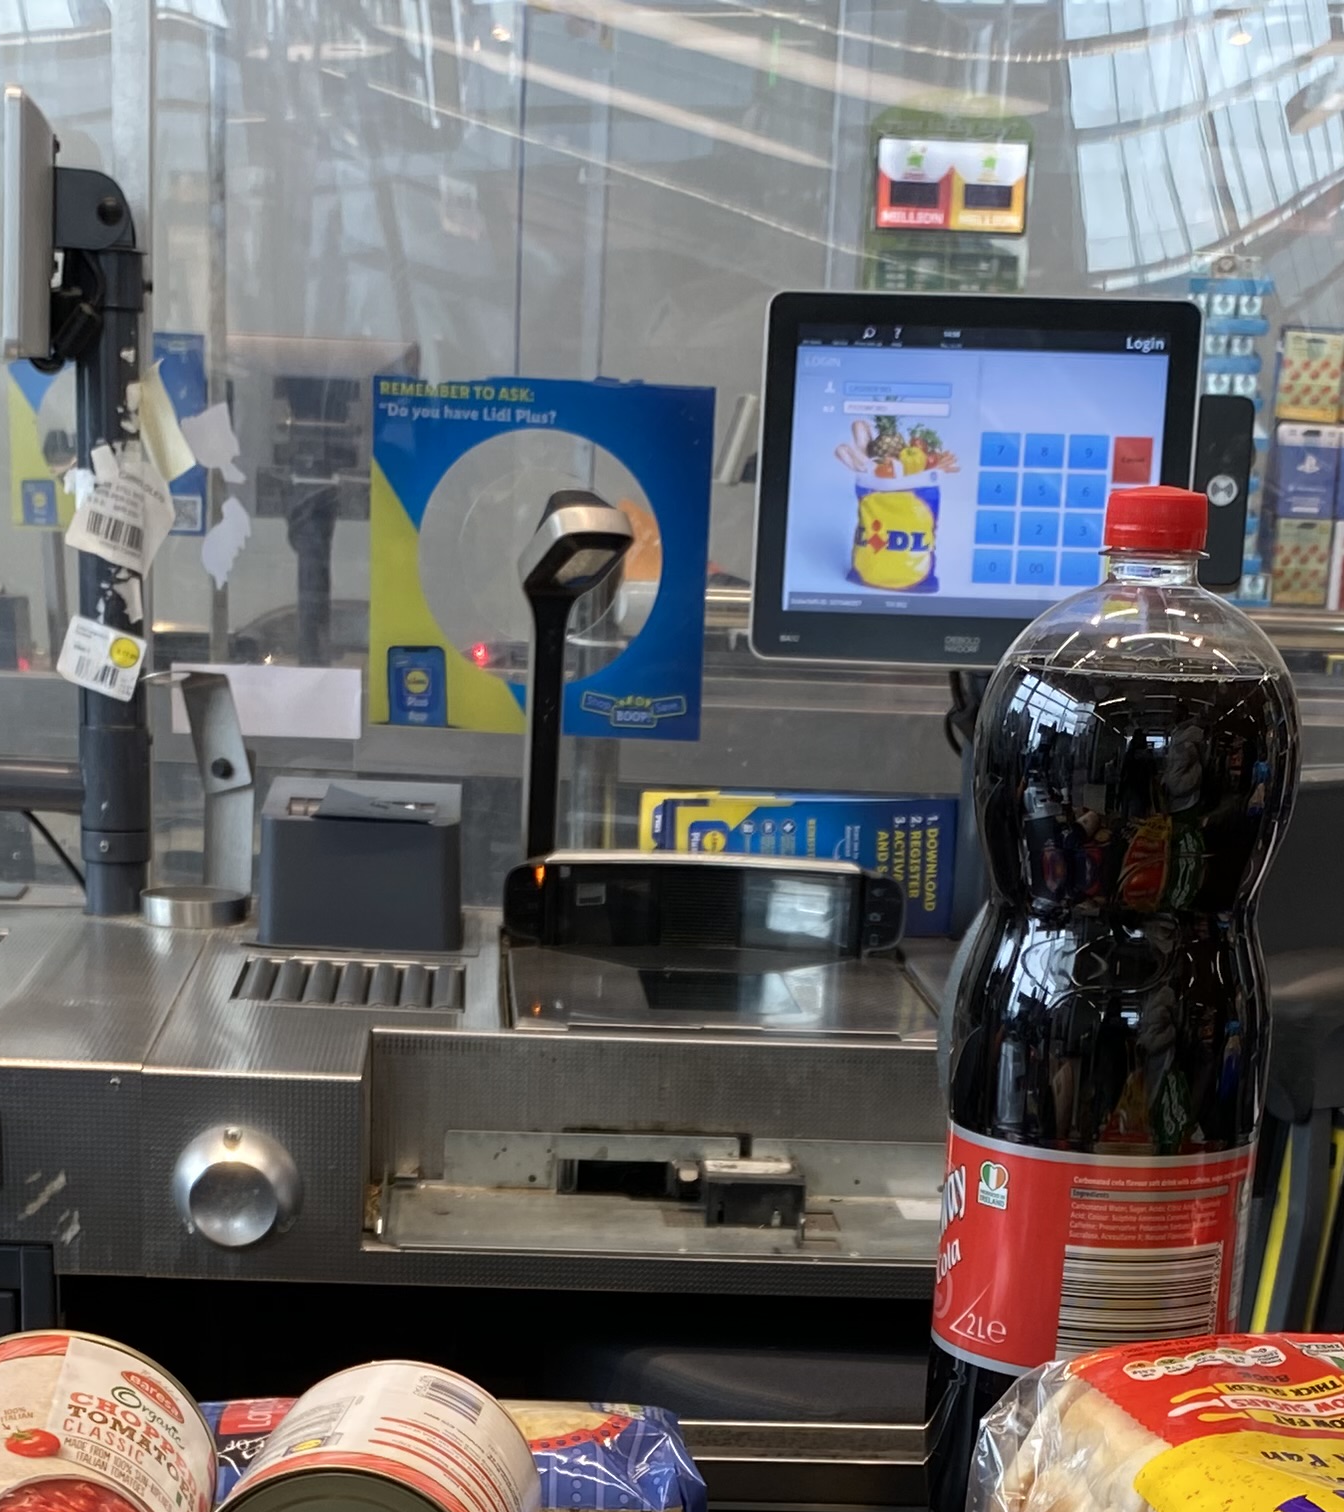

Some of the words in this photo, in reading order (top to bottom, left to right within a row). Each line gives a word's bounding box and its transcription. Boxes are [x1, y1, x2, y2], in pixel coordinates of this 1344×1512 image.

[1125, 336, 1165, 352] Login
[380, 380, 470, 399] REMEMBER
[474, 386, 495, 400] TO
[498, 387, 535, 402] ASK:
[412, 406, 440, 421] you
[443, 405, 479, 421] have
[483, 407, 511, 422] Lidl
[515, 409, 557, 424] Plus?
[877, 831, 889, 863] AND
[908, 830, 921, 899] REGISTER
[924, 828, 939, 912] DOWNLOAD
[1073, 1190, 1110, 1198] Ingredients
[128, 1373, 180, 1417] Baresa
[1289, 1379, 1343, 1395] THICK
[0, 1411, 34, 1422] ITALIAN
[111, 1386, 185, 1450] Organic
[1230, 1398, 1313, 1413] SUGARS
[1274, 1414, 1311, 1427] FAT
[63, 1418, 144, 1465] CLASSIC
[63, 1437, 89, 1454] MADE
[90, 1443, 113, 1463] FROM
[113, 1454, 133, 1476] 100%
[74, 1451, 109, 1473] ITALIAN
[110, 1465, 146, 1496] TOMATOES
